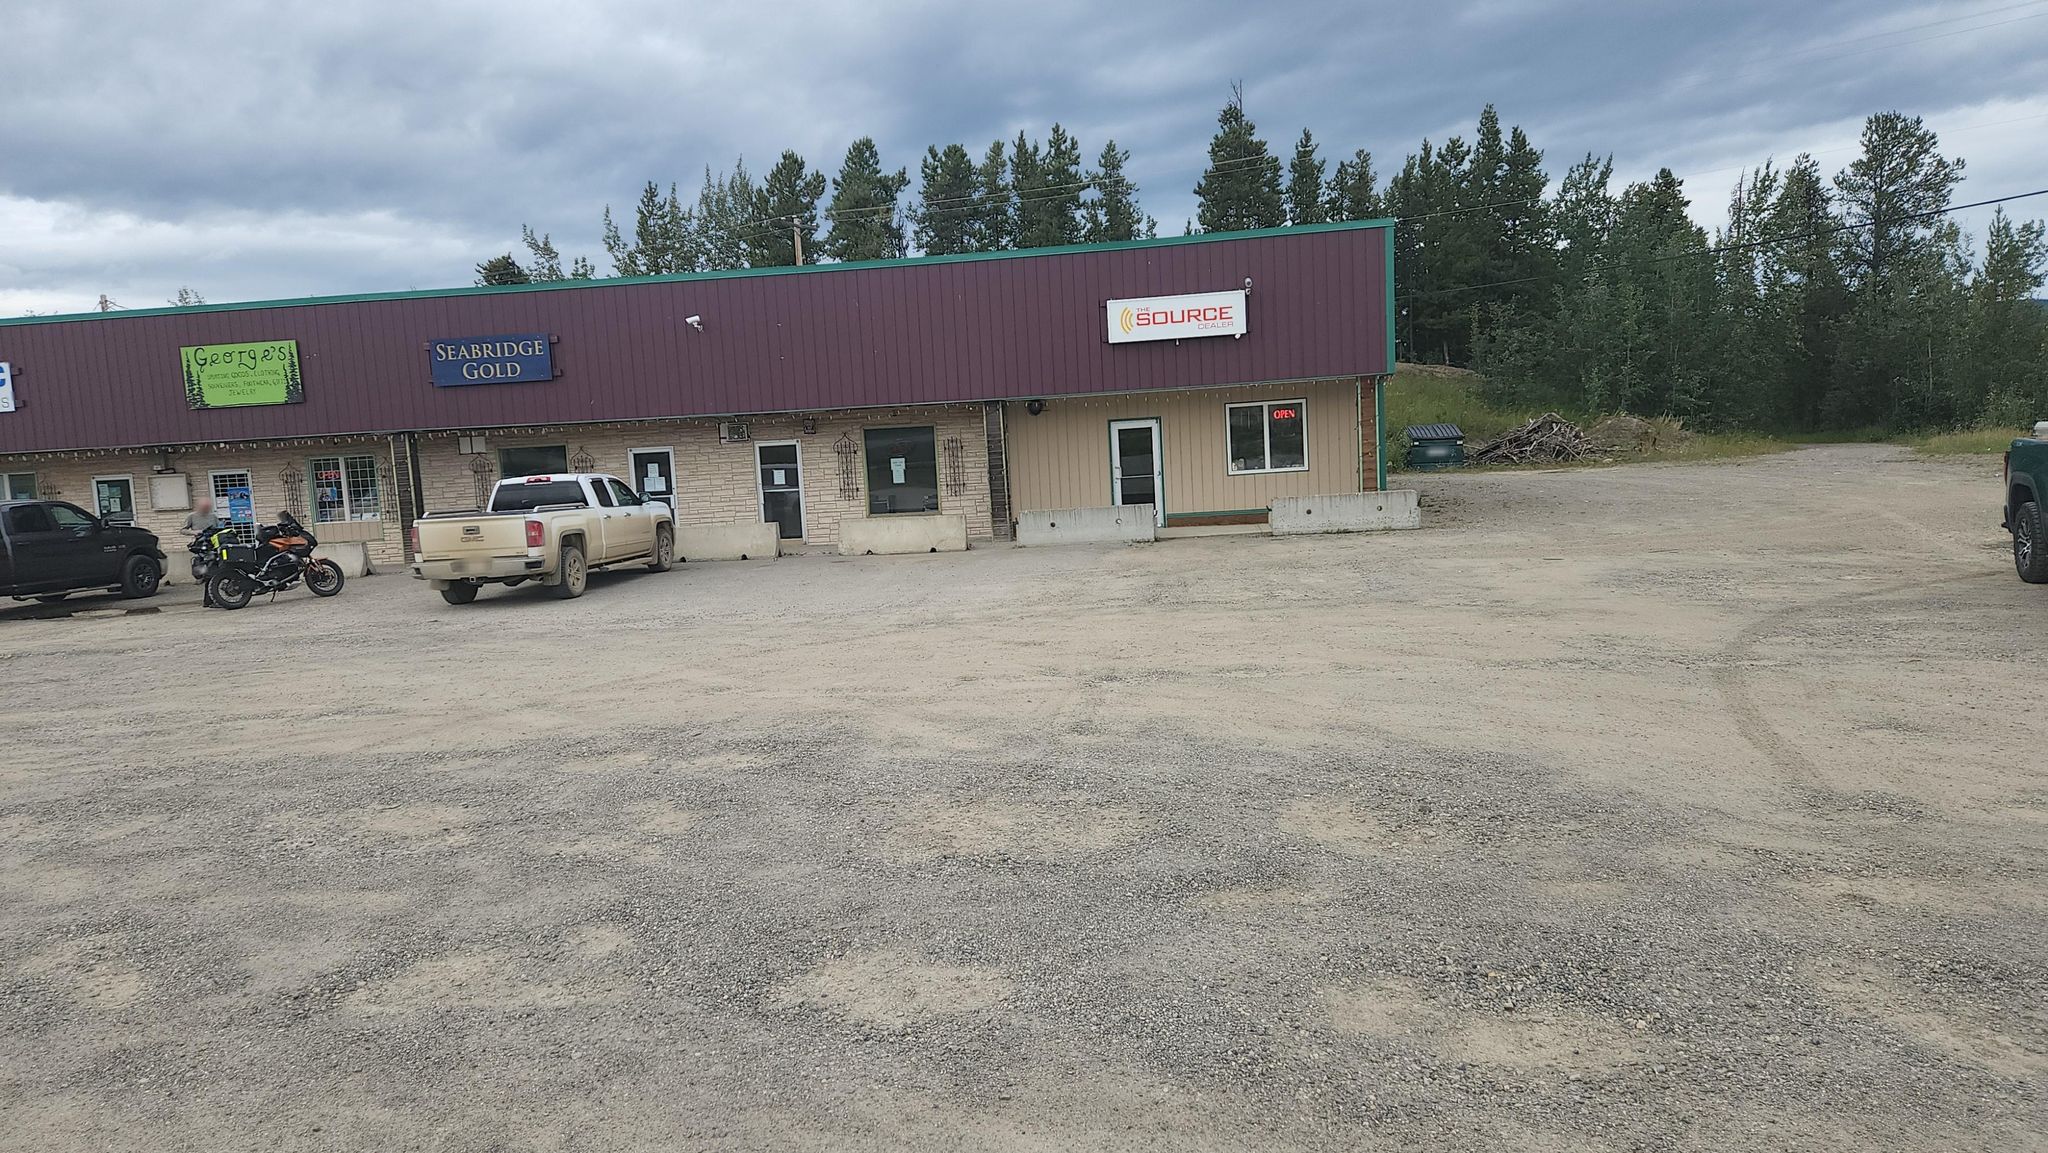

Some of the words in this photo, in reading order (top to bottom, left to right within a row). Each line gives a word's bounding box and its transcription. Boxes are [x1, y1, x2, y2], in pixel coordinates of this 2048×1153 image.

[1136, 306, 1233, 326] SOURCE
[1198, 321, 1234, 330] DEALER
[436, 340, 544, 361] SEABRIDGE
[462, 362, 521, 379] GOLD
[1273, 409, 1295, 419] OPEN
[318, 470, 341, 479] OPEN
